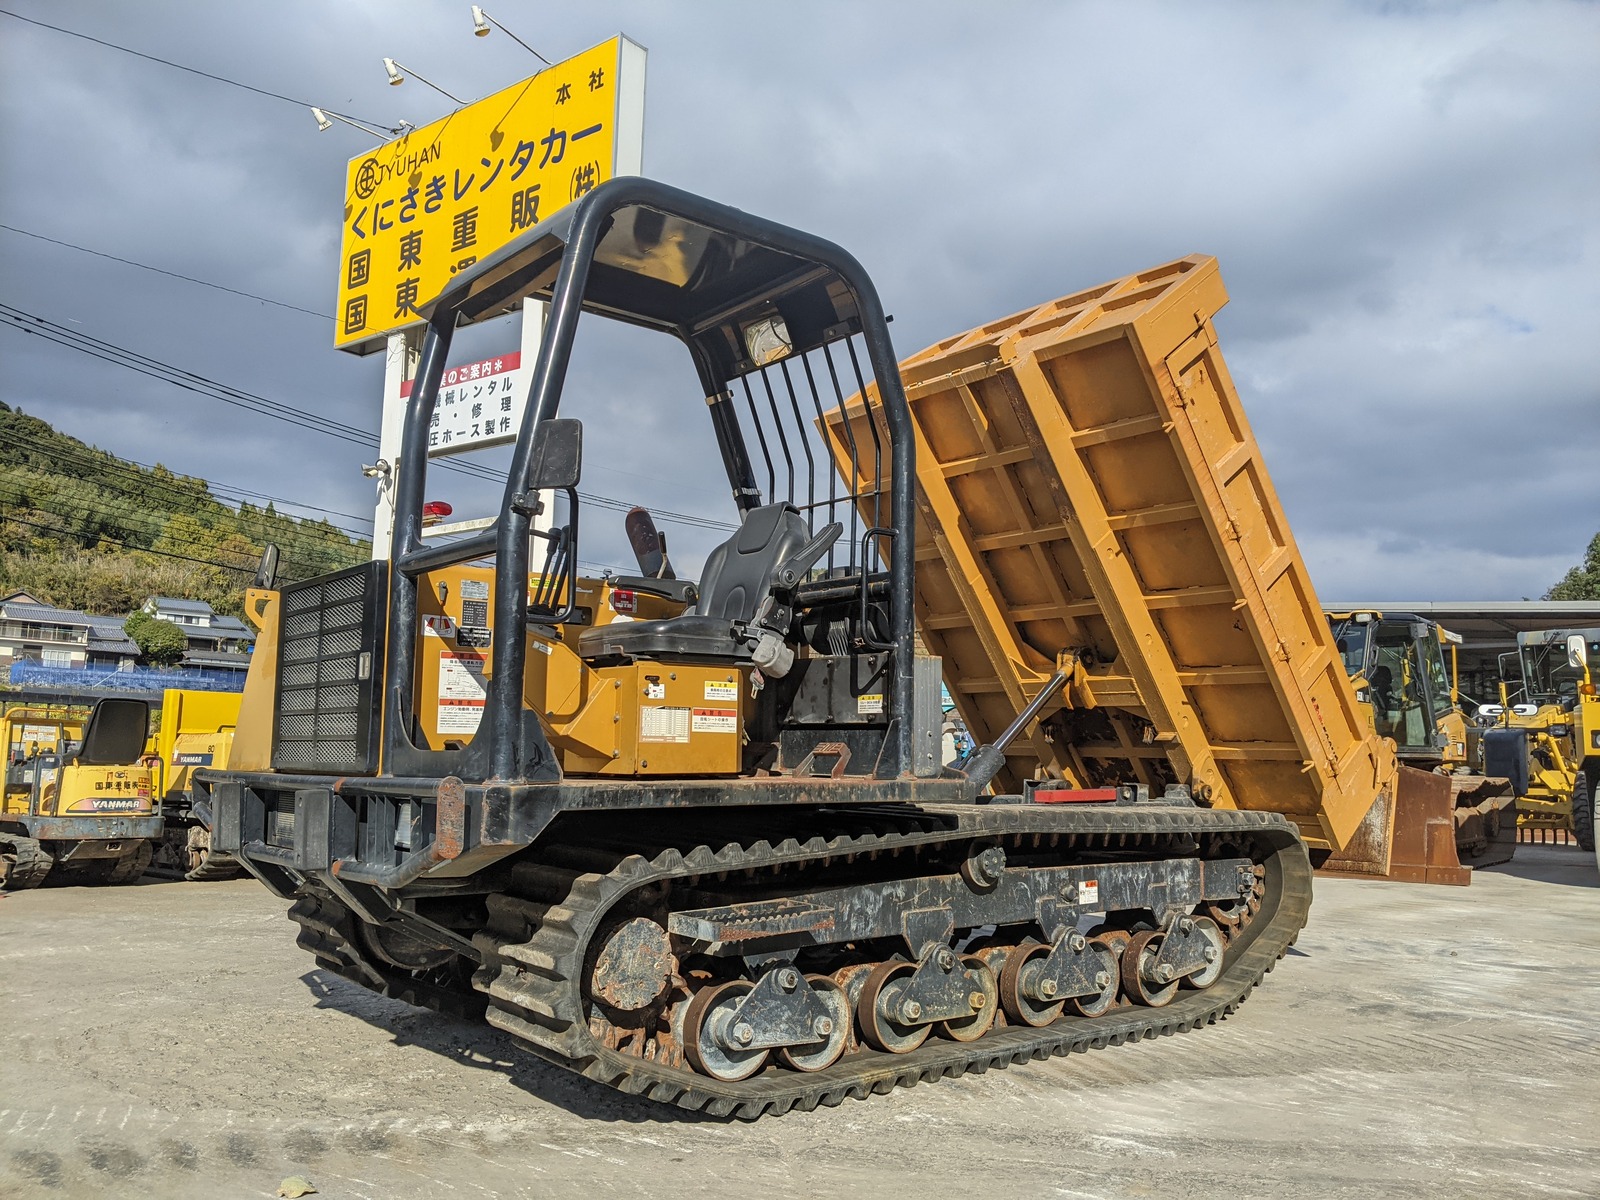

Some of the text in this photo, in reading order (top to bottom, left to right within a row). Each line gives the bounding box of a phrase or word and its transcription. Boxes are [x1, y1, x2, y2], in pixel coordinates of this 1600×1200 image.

[556, 67, 604, 105] 本社
[351, 122, 602, 240] くにさきレンタカー
[374, 140, 441, 186] JYUHAN
[180, 756, 203, 764] YANMAR
[92, 800, 140, 810] YANMAR
